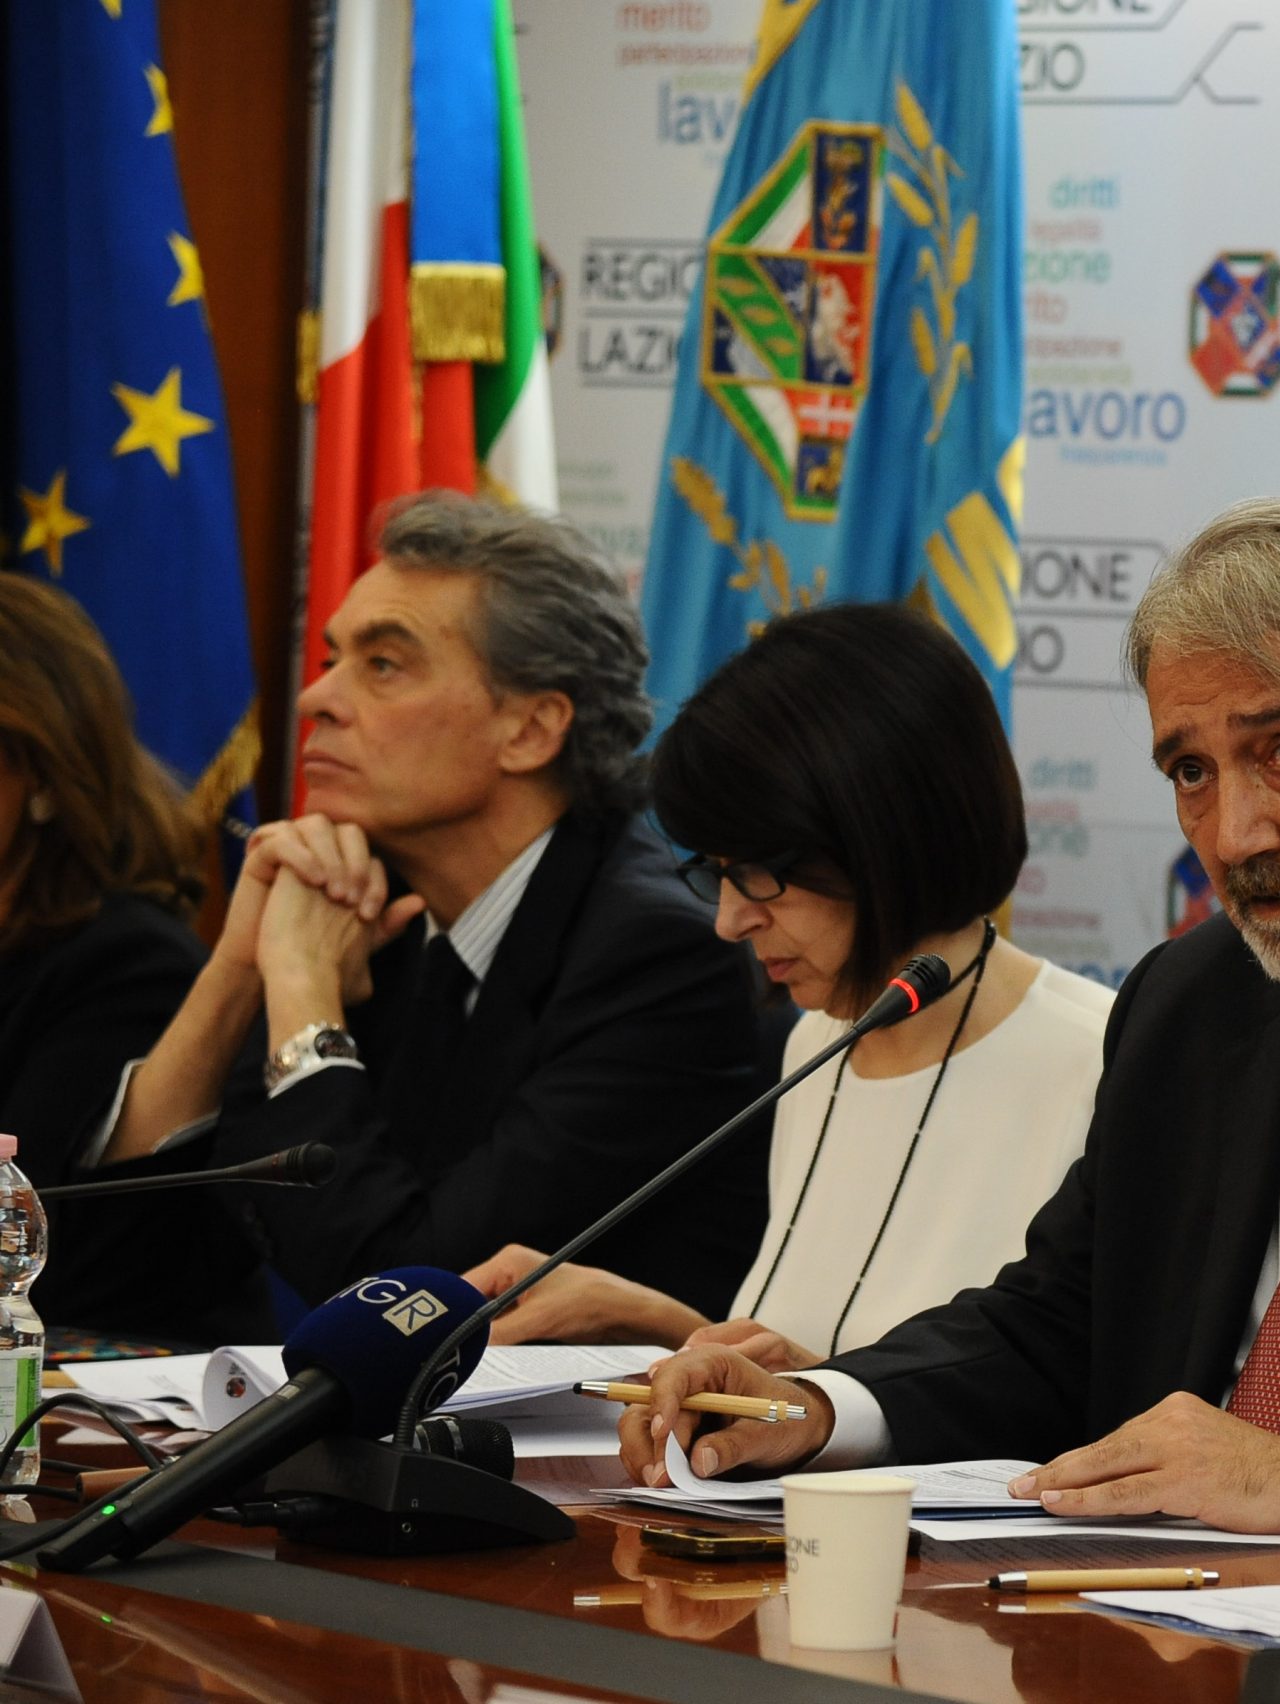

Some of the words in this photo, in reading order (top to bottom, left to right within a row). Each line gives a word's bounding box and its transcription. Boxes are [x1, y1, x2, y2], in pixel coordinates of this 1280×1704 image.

[1020, 41, 1086, 92] ZIO
[657, 78, 738, 146] lav
[583, 253, 697, 301] REGI
[579, 326, 675, 374] LAZI
[1028, 387, 1187, 443] avoro
[1022, 550, 1130, 602] IONE
[324, 1276, 440, 1332] TGR
